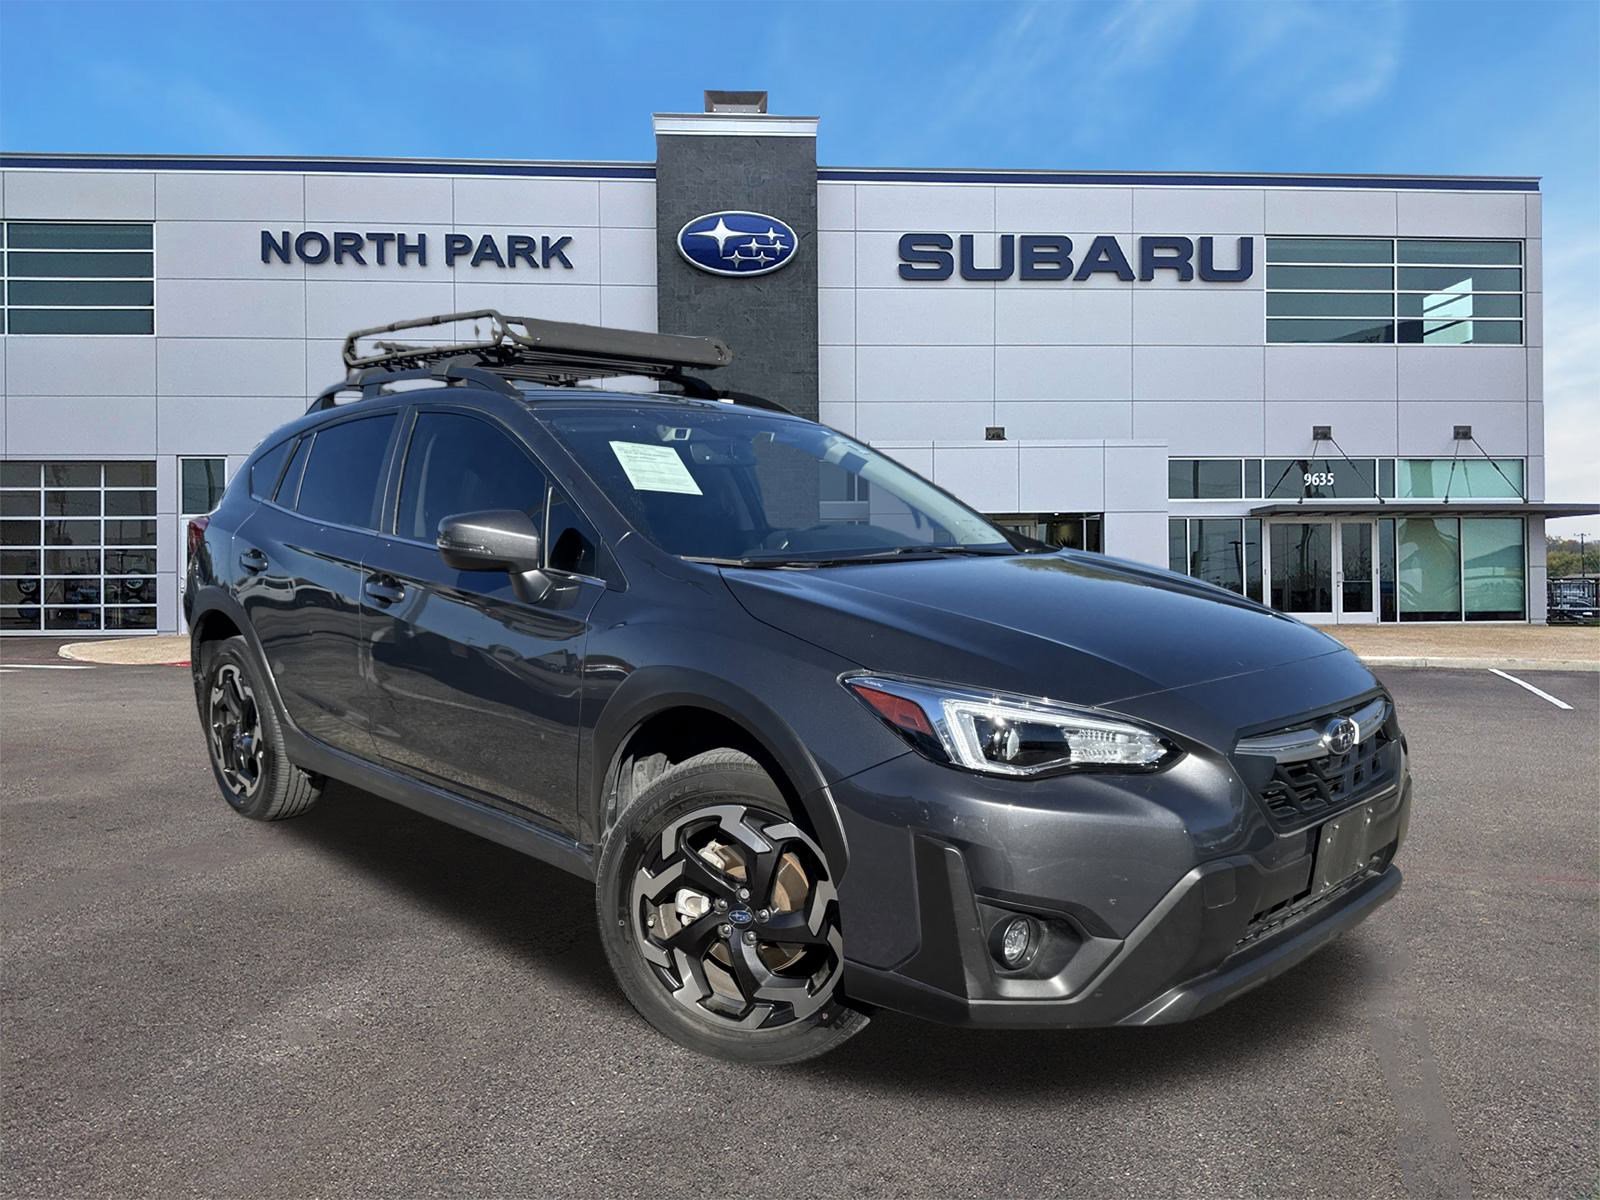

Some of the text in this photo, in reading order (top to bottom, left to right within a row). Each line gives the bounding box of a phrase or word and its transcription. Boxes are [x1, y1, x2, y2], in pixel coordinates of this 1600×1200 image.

[260, 230, 574, 269] NORTH PARK
[897, 232, 1254, 282] SUBARU
[1303, 472, 1335, 486] 9635
